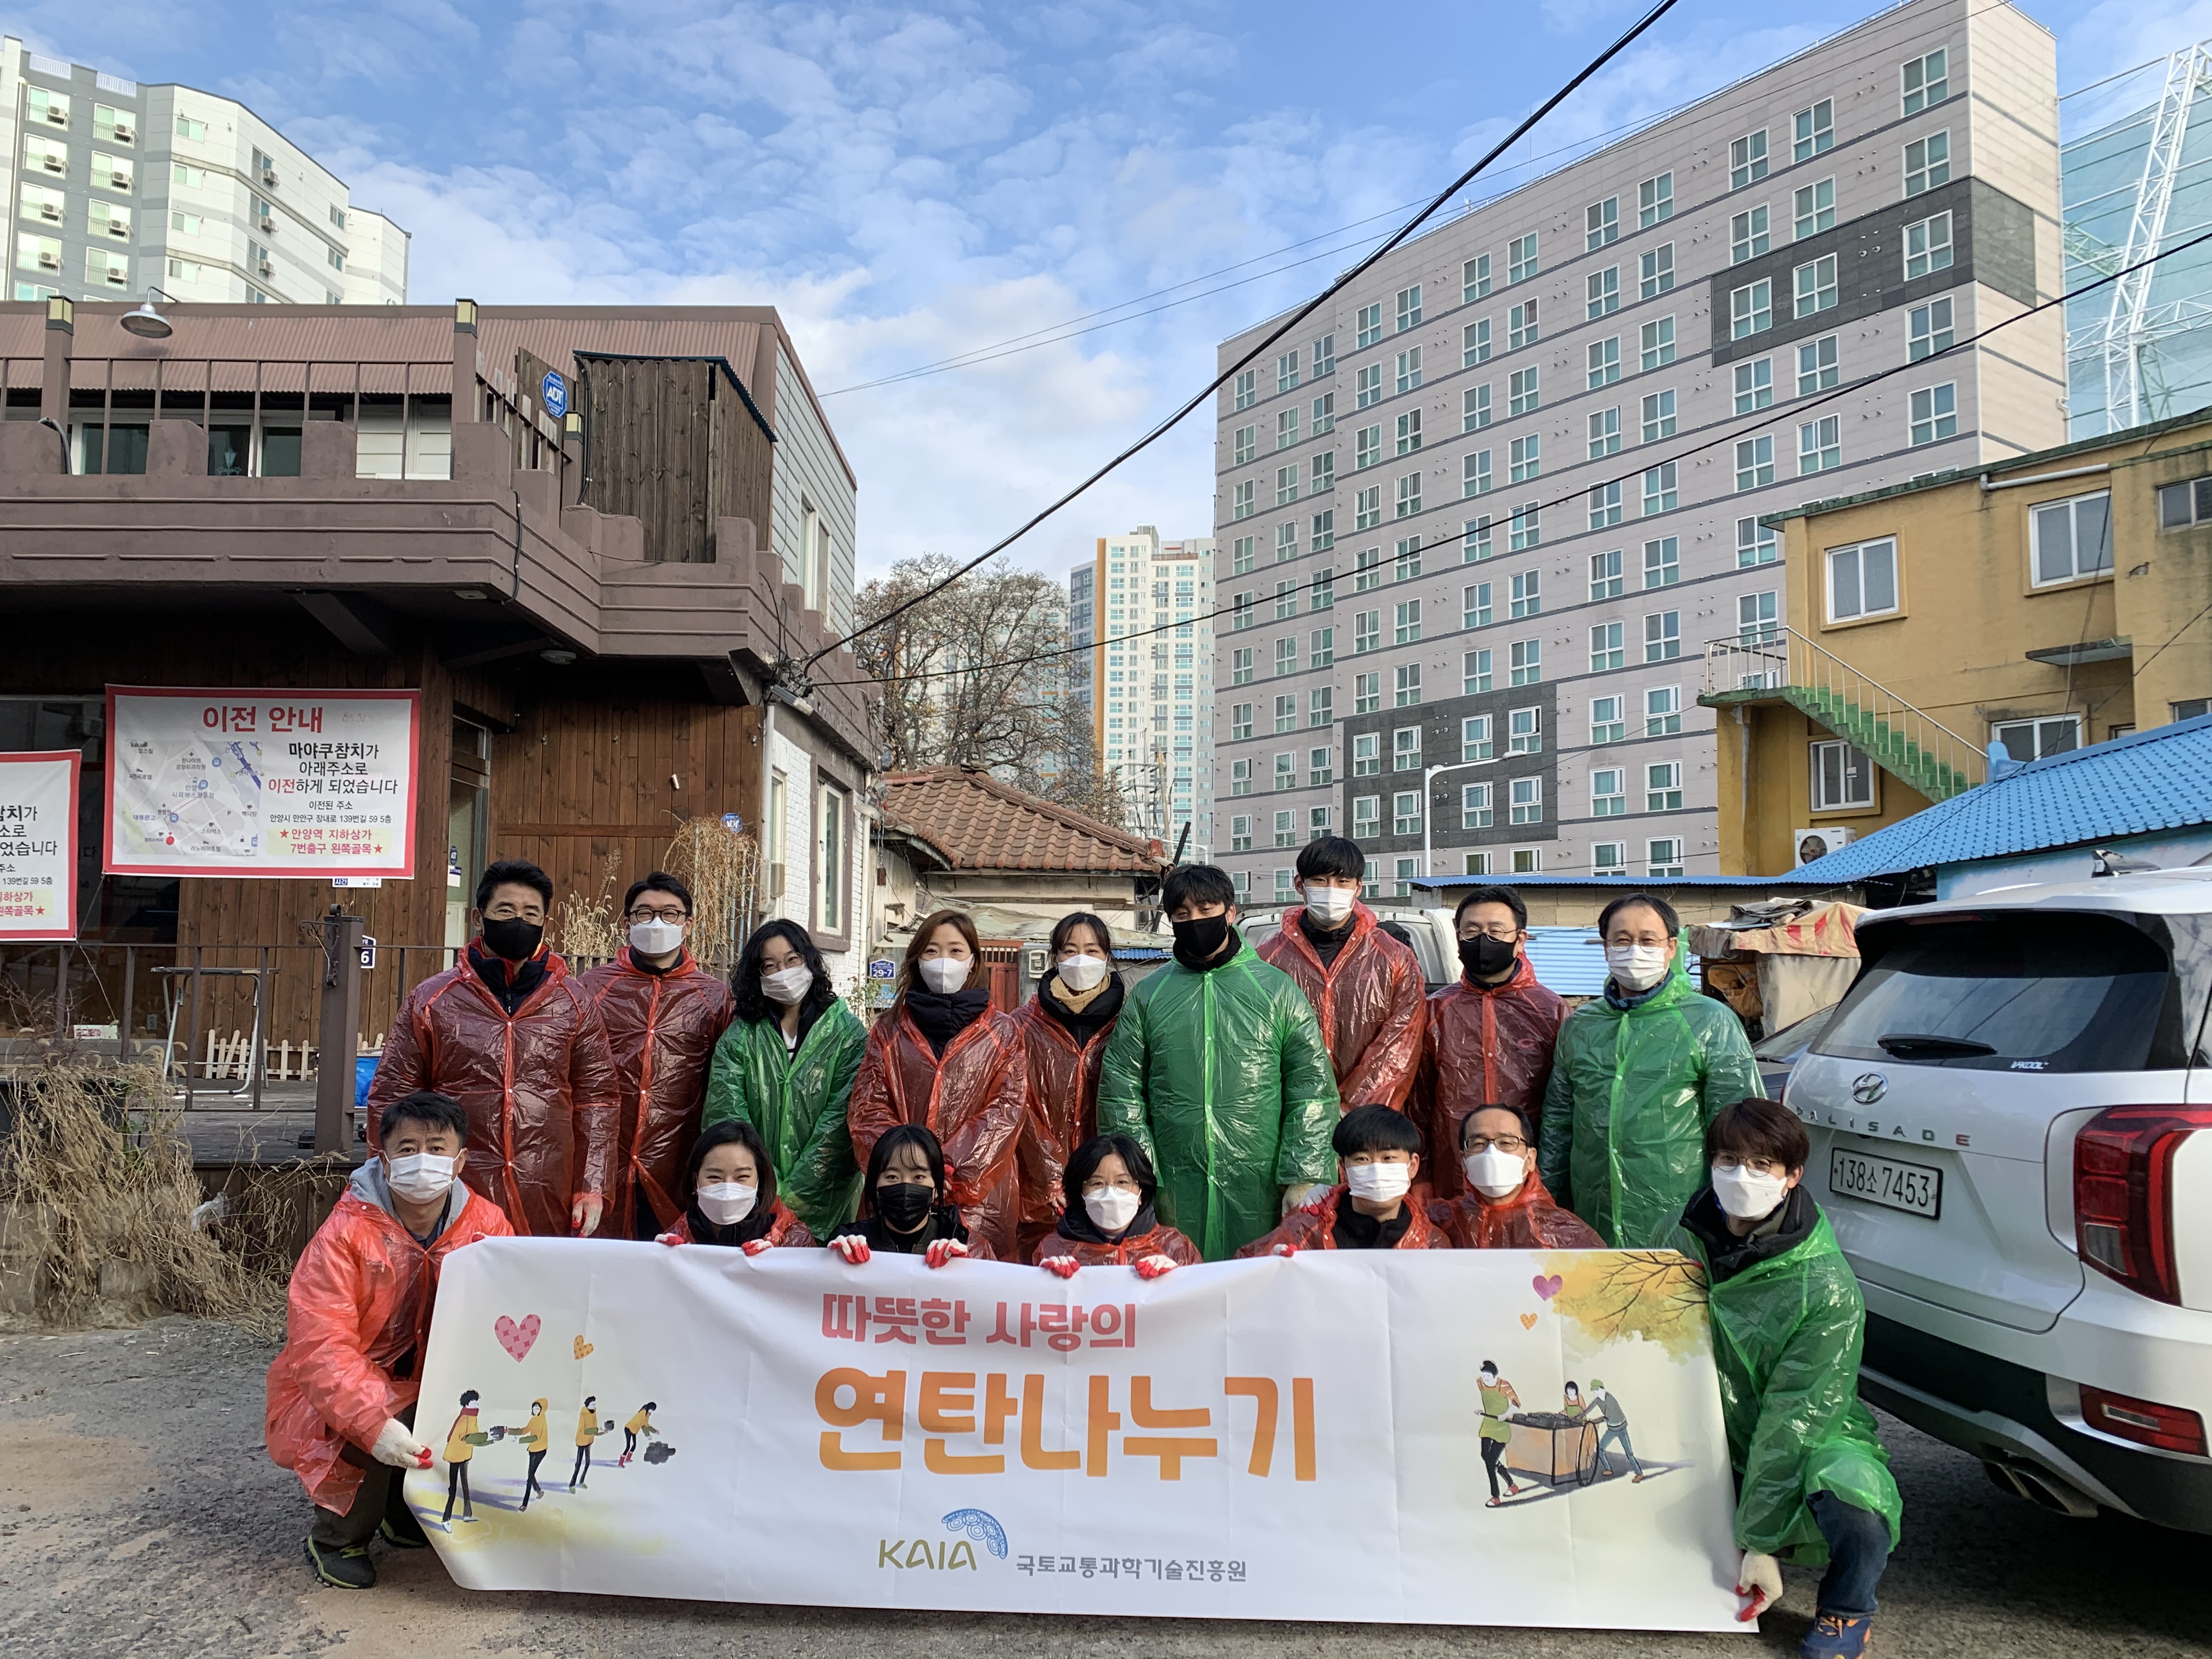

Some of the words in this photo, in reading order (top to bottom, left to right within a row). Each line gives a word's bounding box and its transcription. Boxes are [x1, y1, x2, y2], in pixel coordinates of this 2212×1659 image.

[548, 385, 563, 405] ADT
[204, 706, 256, 732] 이전
[269, 706, 323, 733] 안내
[289, 742, 379, 759] 마야쿠참치가
[300, 761, 368, 776] 아래주소로
[268, 778, 323, 794] 이전하게
[328, 779, 398, 794] 되었습니다
[309, 800, 333, 810] 이전된
[336, 801, 353, 810] 주소
[270, 814, 290, 823] 안양시
[293, 815, 313, 823] 만안구
[316, 815, 337, 823] 장내로
[380, 815, 392, 823] 5층
[291, 829, 323, 840] 안양역
[329, 829, 372, 840] 지하상가
[291, 843, 326, 854] 7번출구
[331, 843, 372, 855] 왼쪽골목
[3, 877, 29, 885] 139번길
[41, 877, 53, 885] 5층
[0, 891, 33, 902] 하상가
[873, 969, 893, 977] 29-7
[1796, 1107, 1971, 1147] PALISADE
[1839, 1156, 1877, 1194] 138소
[1883, 1167, 1930, 1207] 7453
[821, 1293, 971, 1346] 따뜻한
[986, 1302, 1136, 1352] 사랑의
[815, 1367, 1316, 1481] 연탄나누기
[878, 1539, 977, 1572] KAIA
[1016, 1555, 1246, 1582] 국토교통과학기술진흥원
